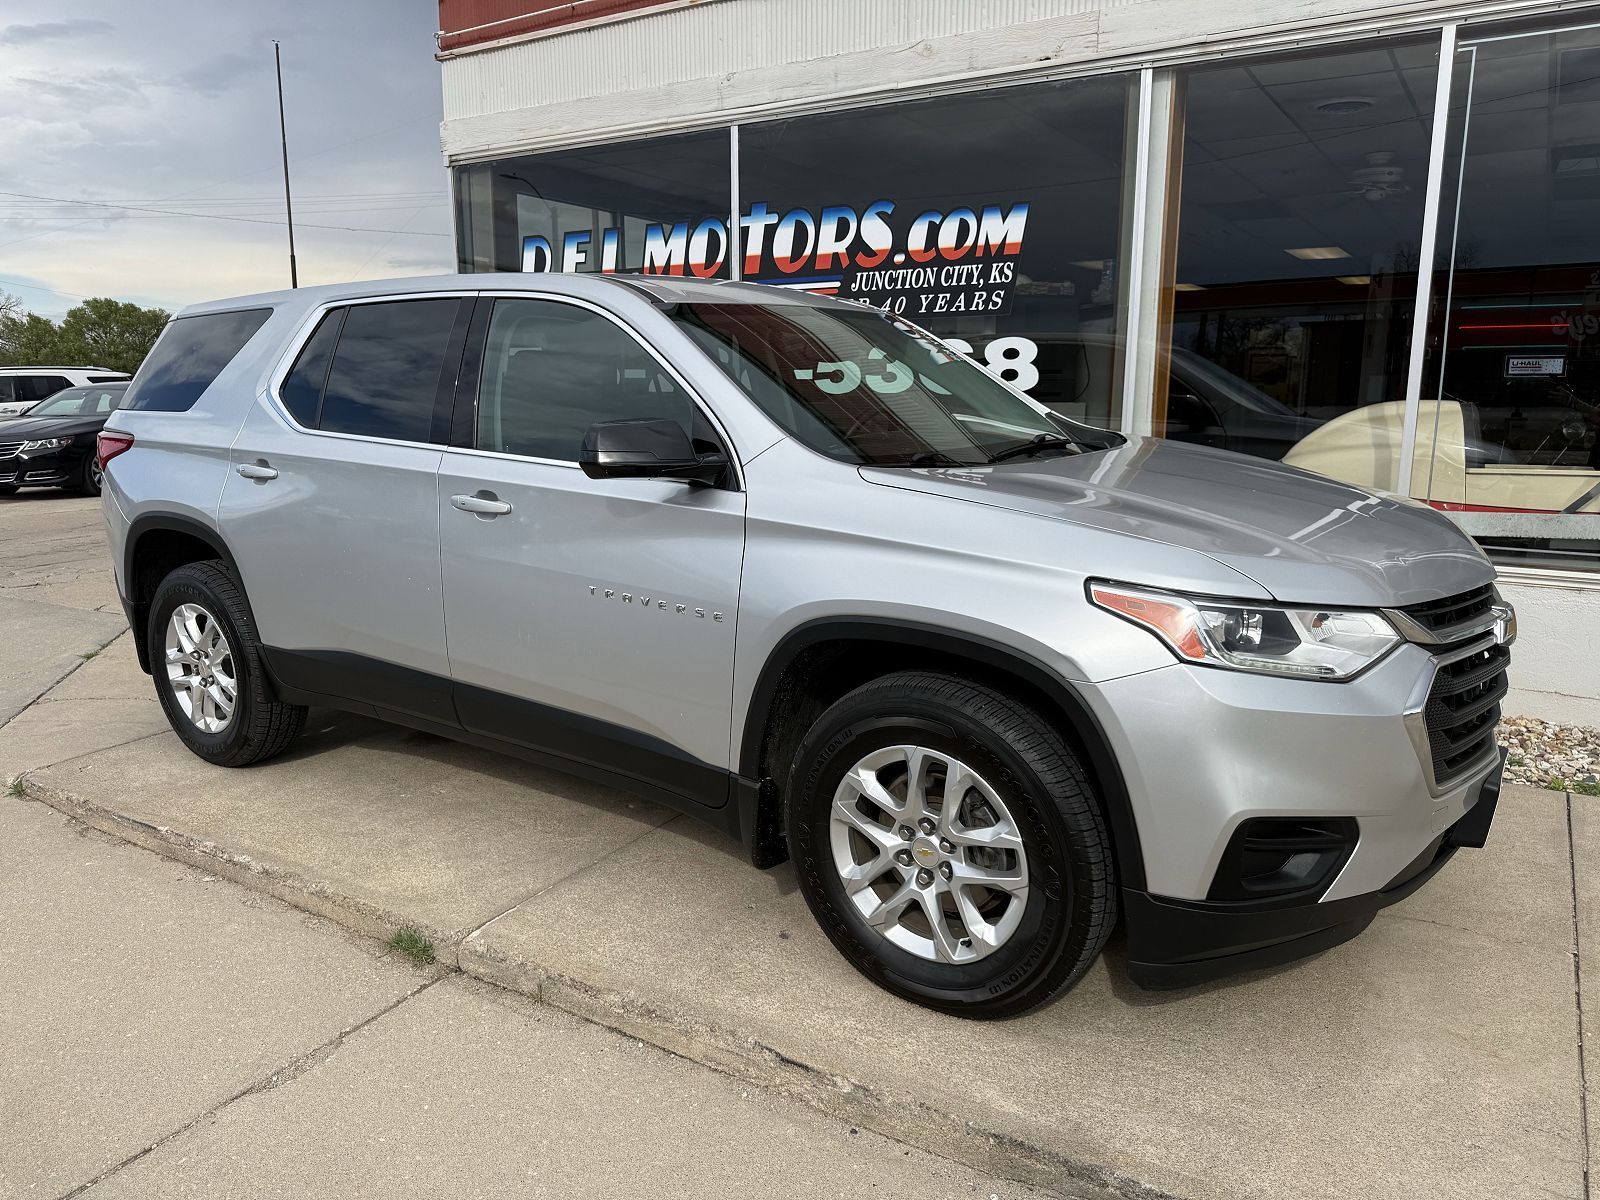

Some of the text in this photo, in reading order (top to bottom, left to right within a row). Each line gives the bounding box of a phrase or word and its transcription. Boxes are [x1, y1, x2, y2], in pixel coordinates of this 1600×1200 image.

[850, 262, 1015, 292] JUNCTION CITY, KS
[879, 296, 907, 315] 40
[918, 290, 1005, 314] YEARS
[588, 585, 724, 623] TRAVERSE
